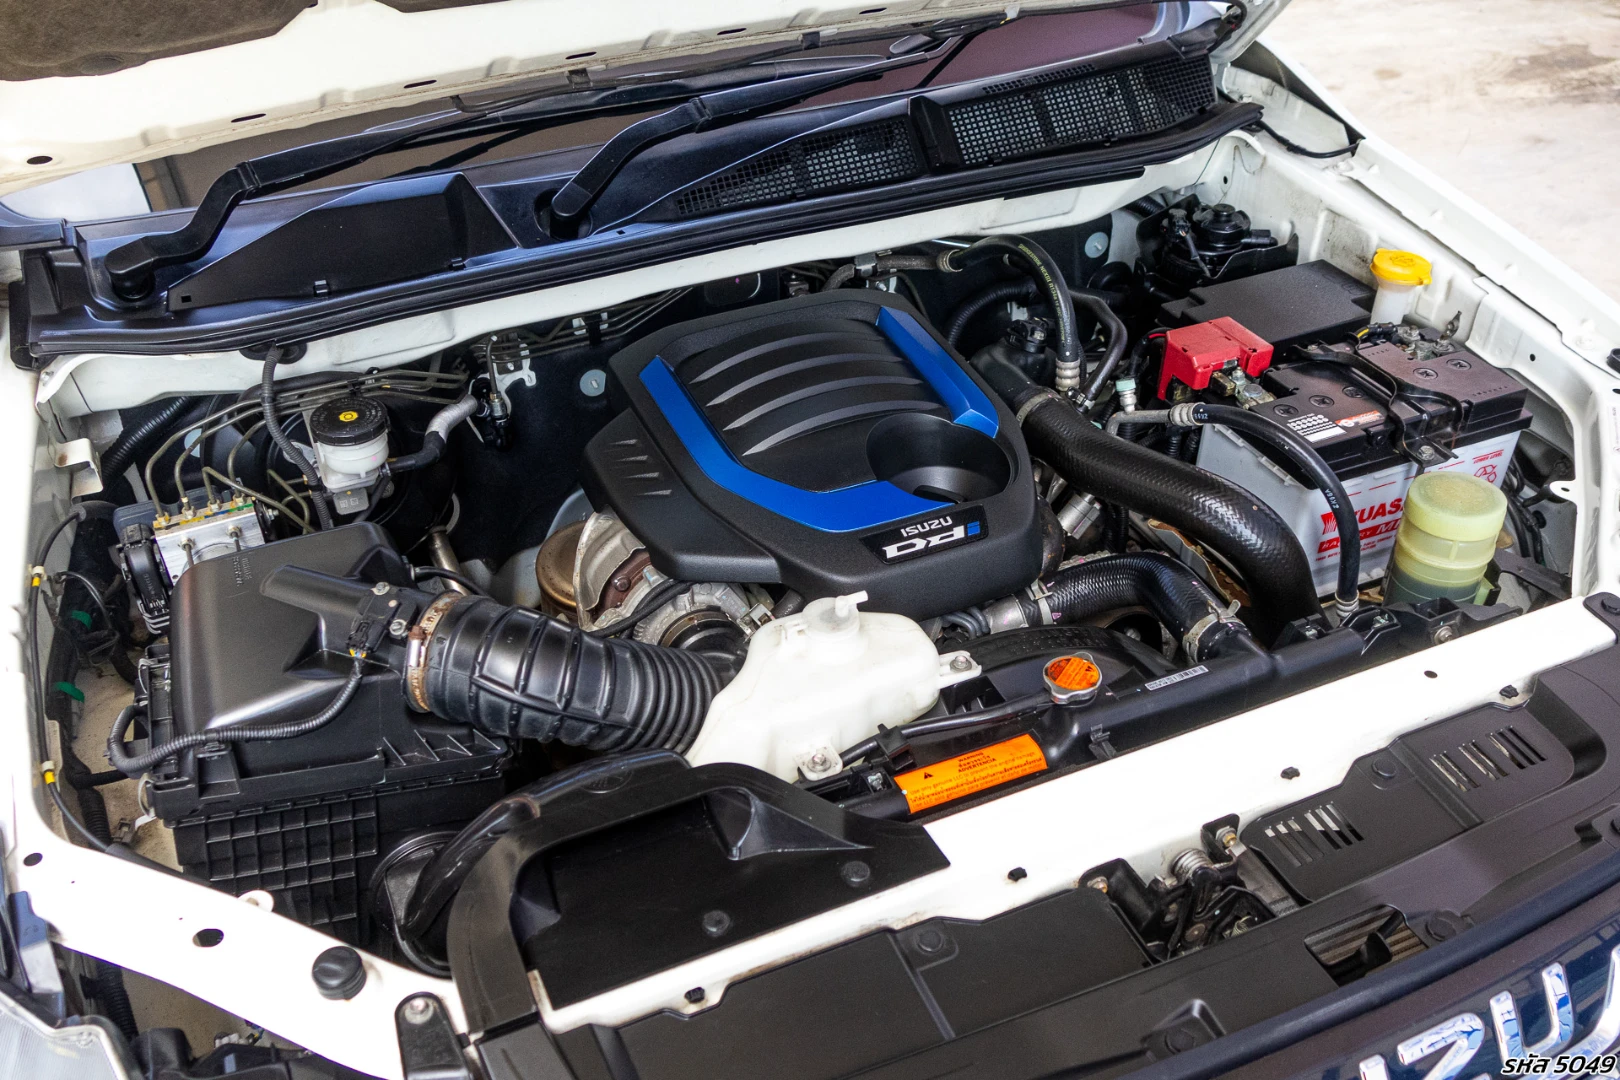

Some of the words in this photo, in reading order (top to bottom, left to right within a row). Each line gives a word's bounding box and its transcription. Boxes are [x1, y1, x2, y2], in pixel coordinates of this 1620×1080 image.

[900, 515, 953, 538] ISUZU
[958, 752, 984, 763] WARNING
[958, 757, 997, 773] ADVERTENCIA
